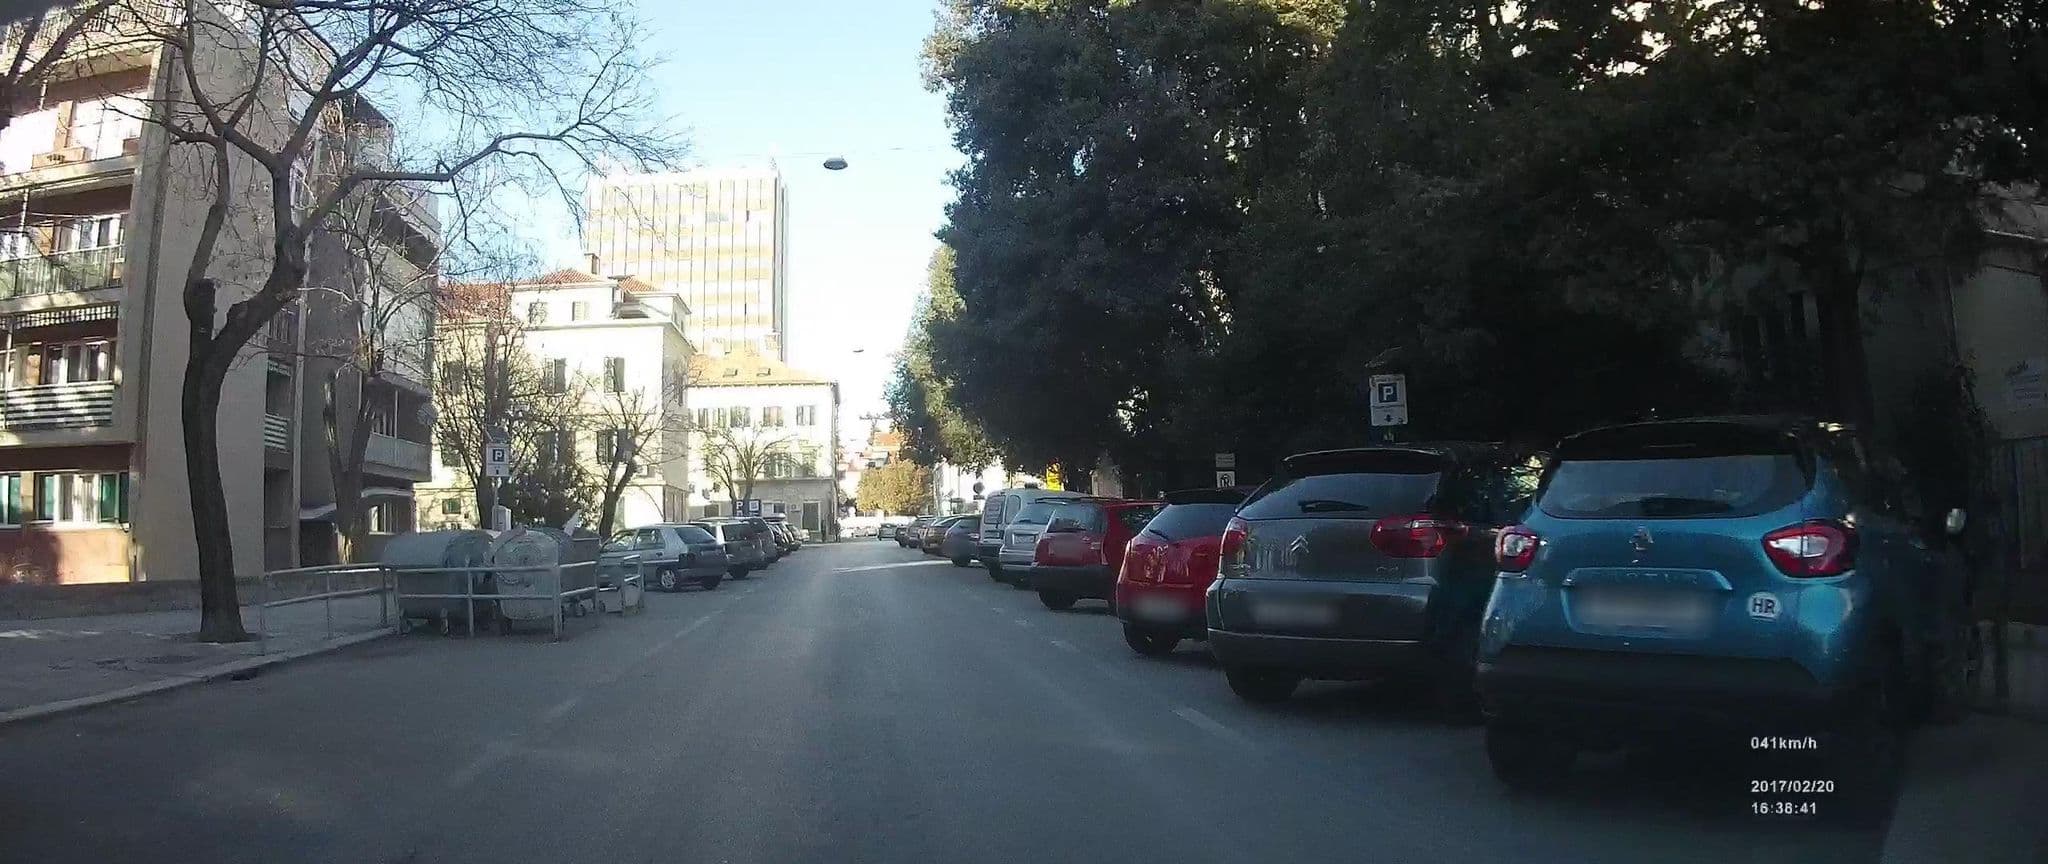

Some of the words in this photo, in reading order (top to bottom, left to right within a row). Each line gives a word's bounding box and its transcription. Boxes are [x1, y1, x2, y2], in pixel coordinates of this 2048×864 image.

[1383, 386, 1394, 401] P
[494, 450, 503, 461] P
[735, 501, 744, 510] P
[1752, 598, 1775, 614] HR
